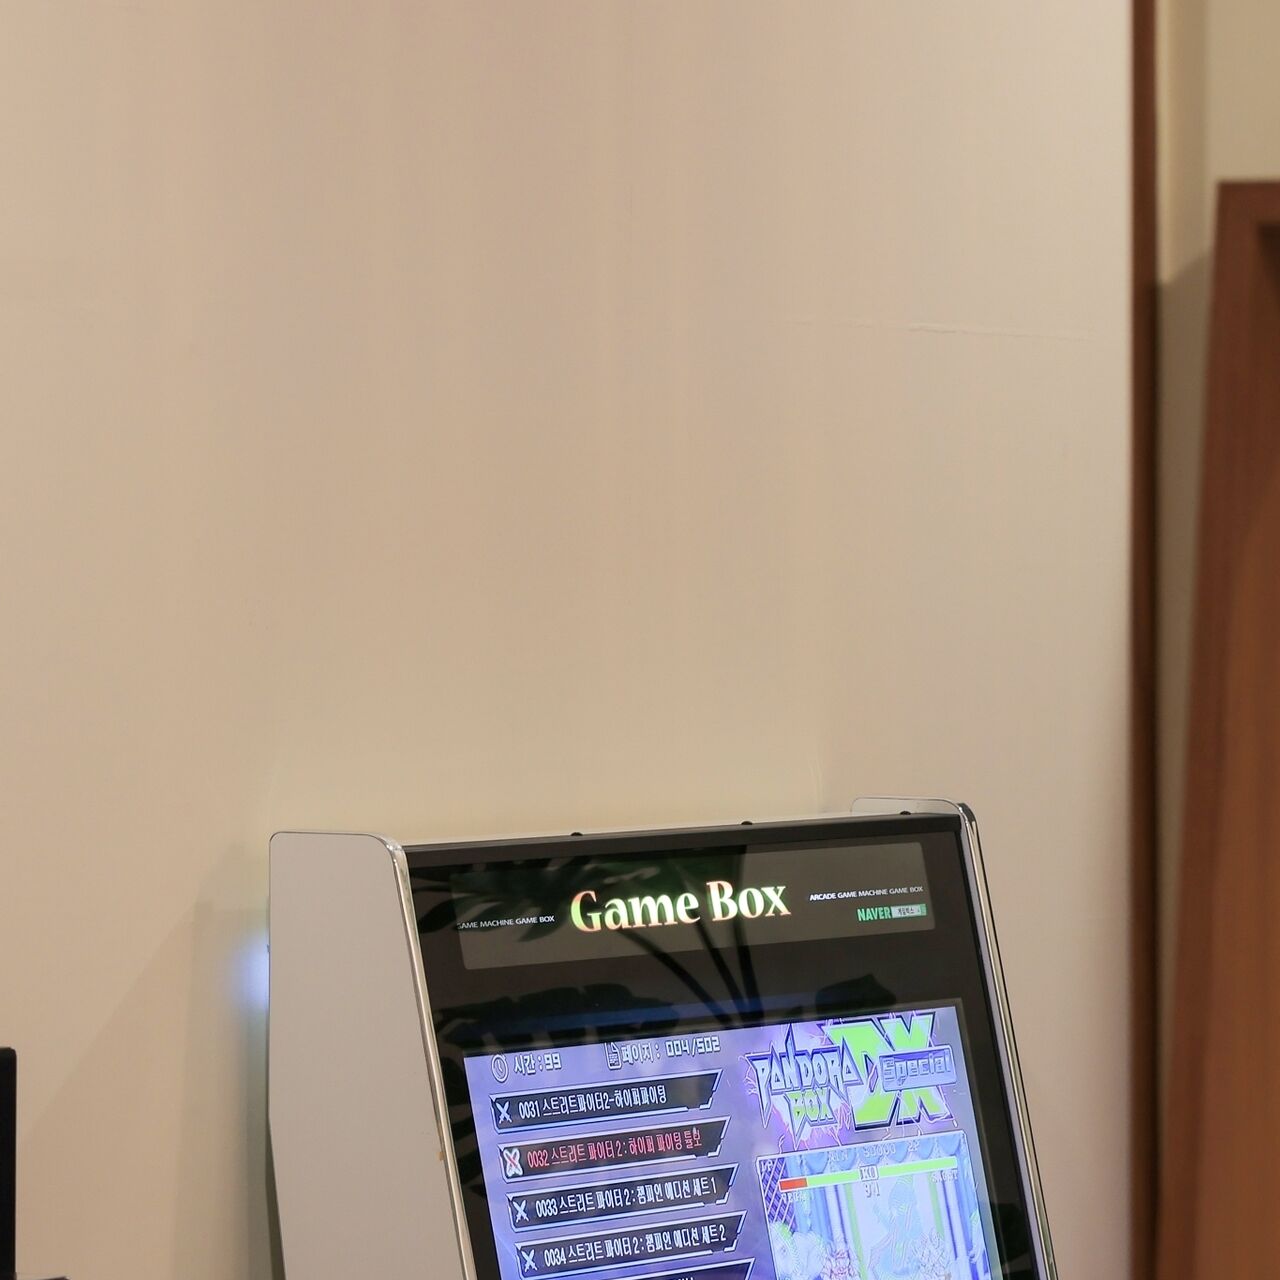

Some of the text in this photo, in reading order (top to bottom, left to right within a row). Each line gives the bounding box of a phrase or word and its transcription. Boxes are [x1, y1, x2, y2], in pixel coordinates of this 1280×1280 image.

[570, 880, 792, 934] Game Box
[809, 893, 837, 902] ARCADE
[837, 890, 858, 899] GAME
[858, 888, 889, 898] MACHINE
[889, 886, 909, 895] GAME
[480, 918, 515, 928] MACHINE
[515, 916, 538, 925] GAME
[539, 915, 555, 923] BOX
[856, 906, 892, 922] NAVER
[744, 1023, 864, 1128] PANDORA
[882, 1052, 952, 1086] Special
[518, 1101, 541, 1119] 0031
[785, 1087, 838, 1142] BOX
[527, 1149, 550, 1169] 0032
[551, 1144, 587, 1165] 스트리트
[587, 1140, 615, 1161] 파이터
[628, 1135, 655, 1156] 하이퍼
[656, 1132, 683, 1152] 파이팅
[535, 1198, 558, 1218] 0033
[560, 1192, 596, 1214] 스트리트
[595, 1188, 623, 1210] 파이터
[664, 1179, 691, 1200] 에디션
[692, 1177, 711, 1197] 세트
[710, 1176, 717, 1194] 1
[544, 1247, 566, 1267] 0034
[568, 1241, 604, 1263] 스트리트
[604, 1237, 632, 1258] 파이터
[673, 1227, 700, 1249] 에디션
[701, 1224, 720, 1244] 세트
[719, 1224, 727, 1242] 2
